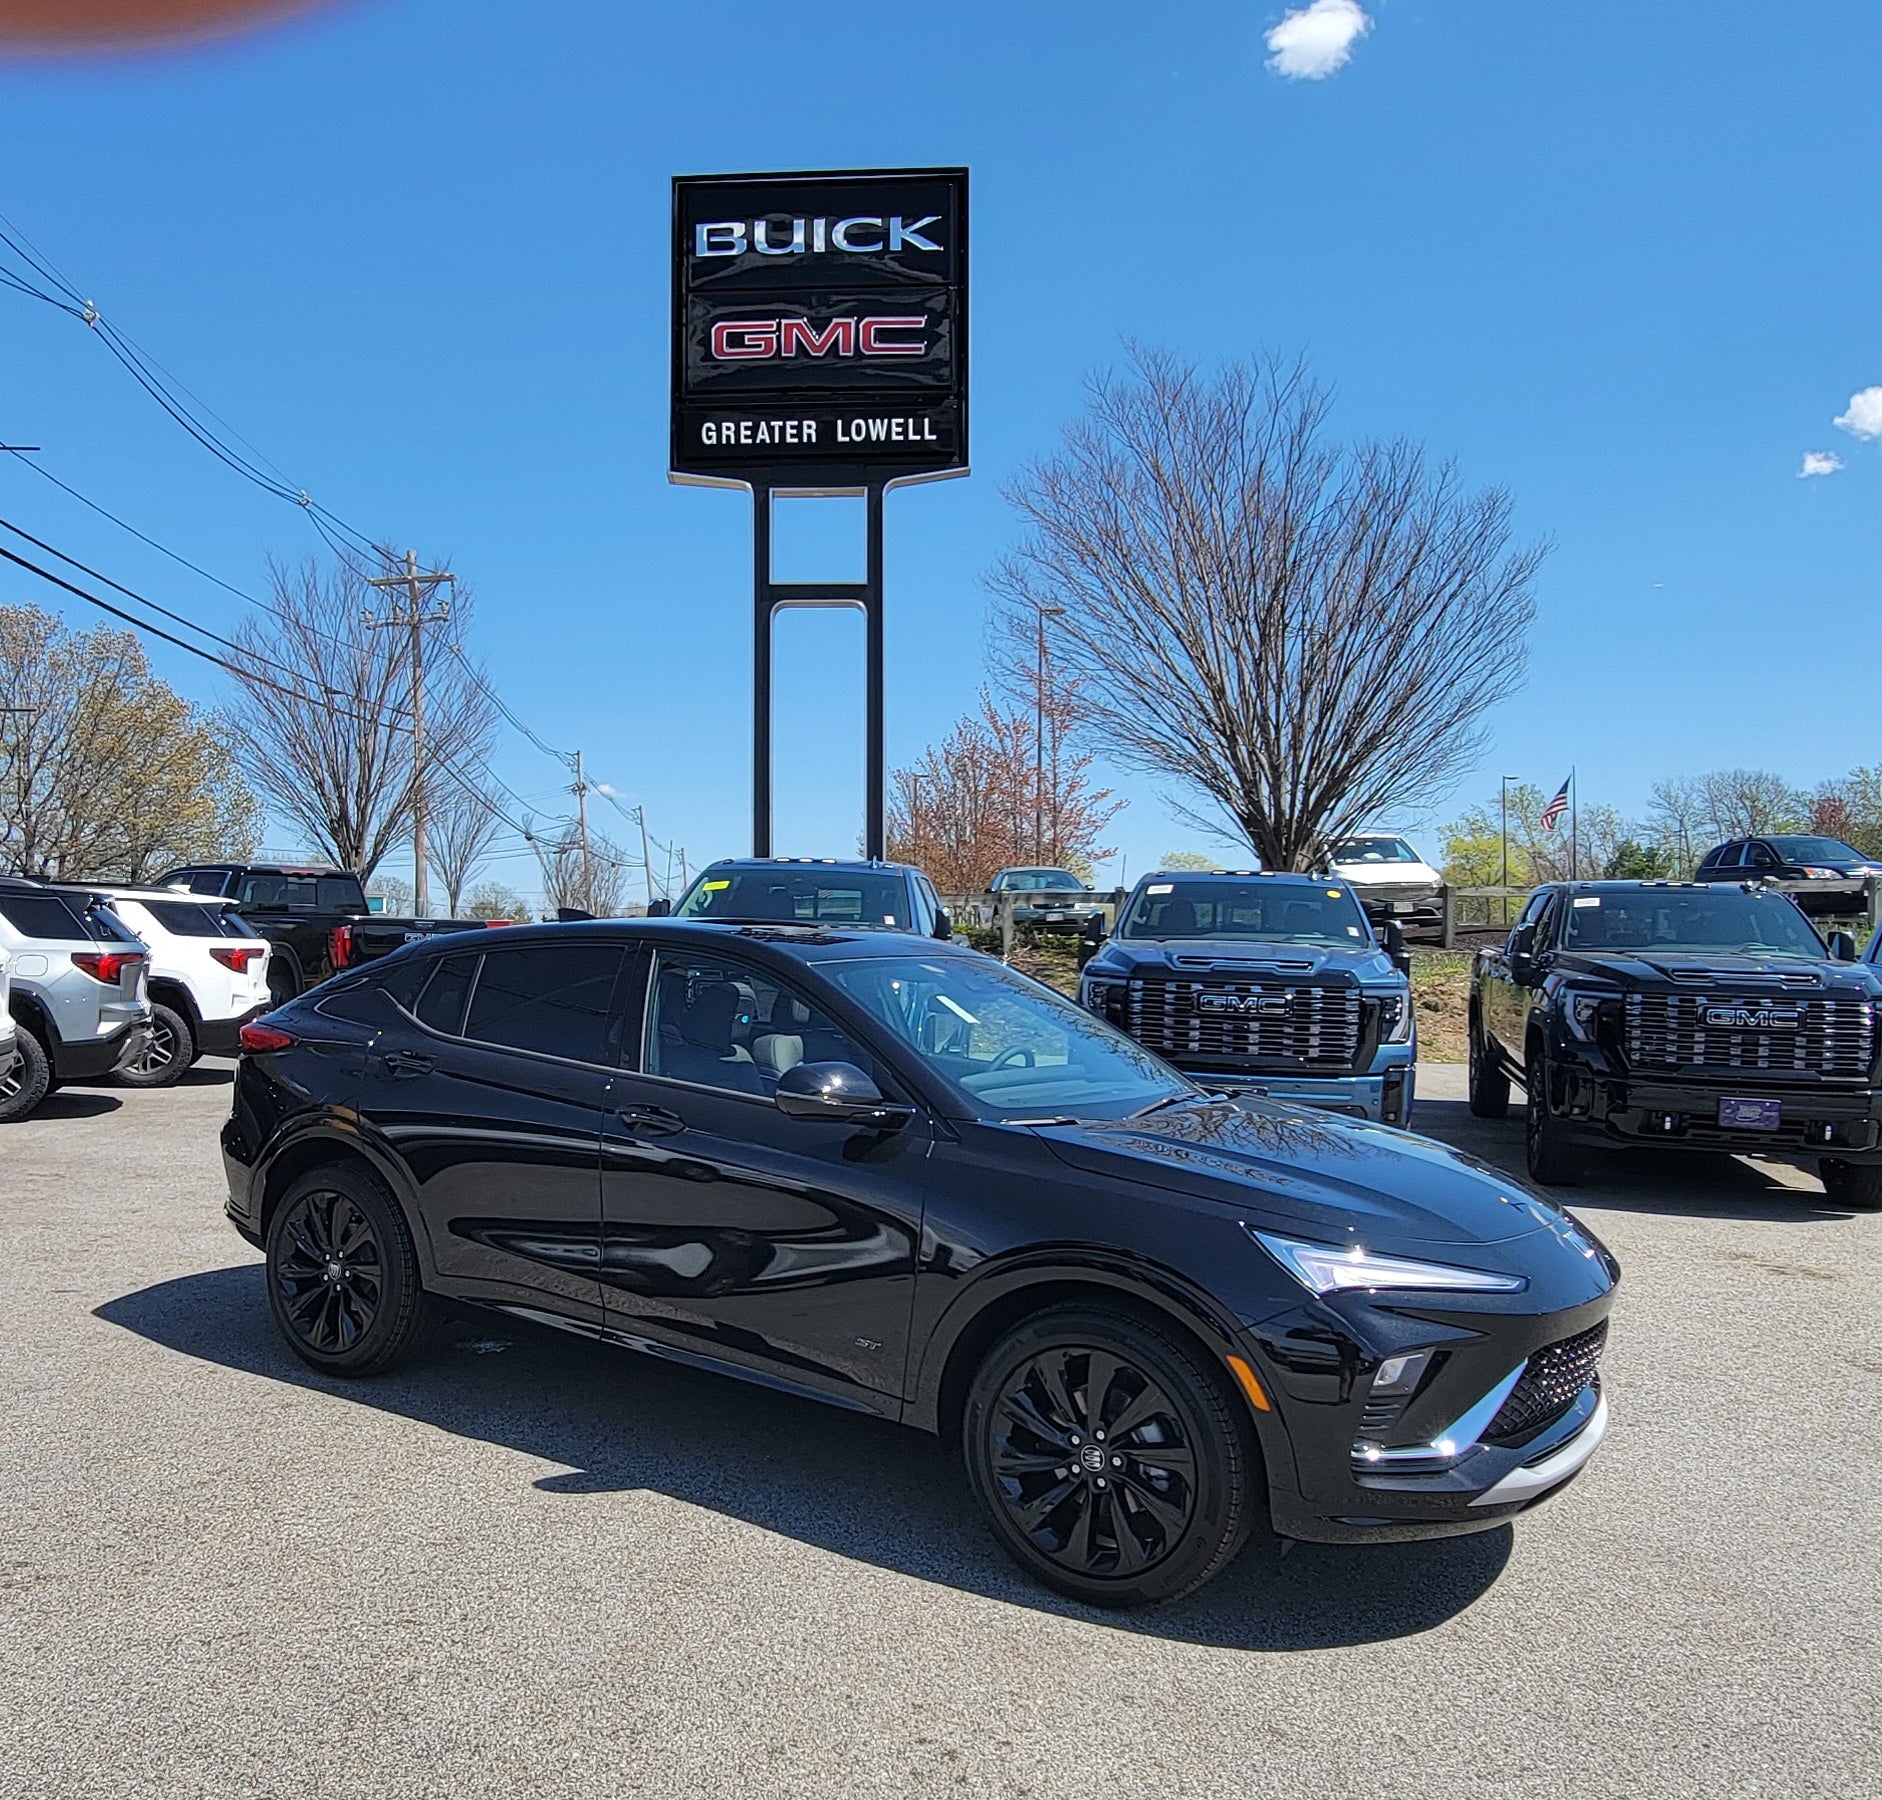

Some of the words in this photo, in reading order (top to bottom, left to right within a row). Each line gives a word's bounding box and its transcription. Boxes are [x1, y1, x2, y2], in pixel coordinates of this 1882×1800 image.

[695, 216, 944, 257] BUICK
[711, 315, 927, 359] GMC
[701, 420, 817, 445] GREATER
[836, 417, 937, 442] LOWELL
[1200, 995, 1286, 1014] GMC
[1706, 1009, 1799, 1028] GMC
[854, 1337, 882, 1350] ST
